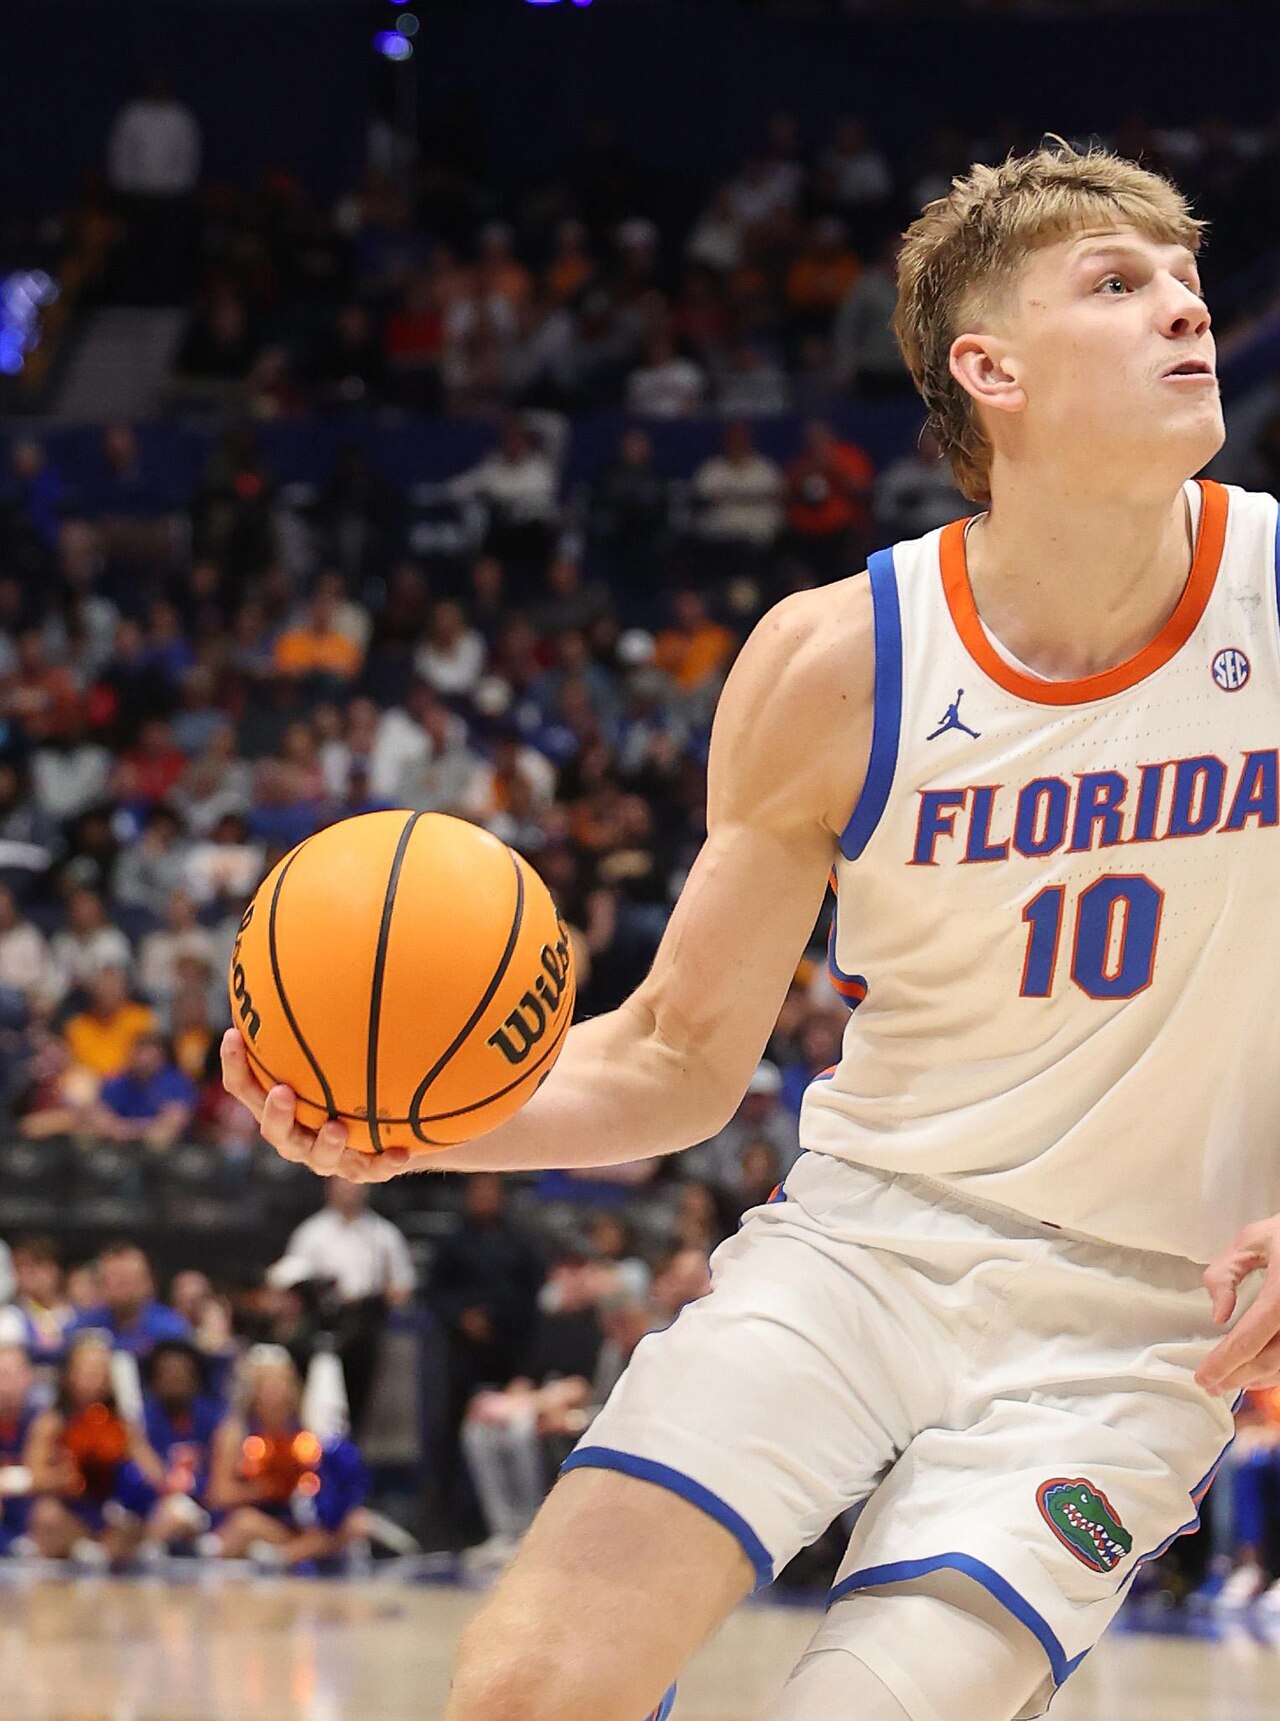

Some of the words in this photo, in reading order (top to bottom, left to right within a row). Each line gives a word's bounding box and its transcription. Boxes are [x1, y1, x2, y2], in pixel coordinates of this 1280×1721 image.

[1213, 650, 1248, 689] SEC
[905, 748, 1280, 867] FLORIDA
[1018, 873, 1165, 1000] 10
